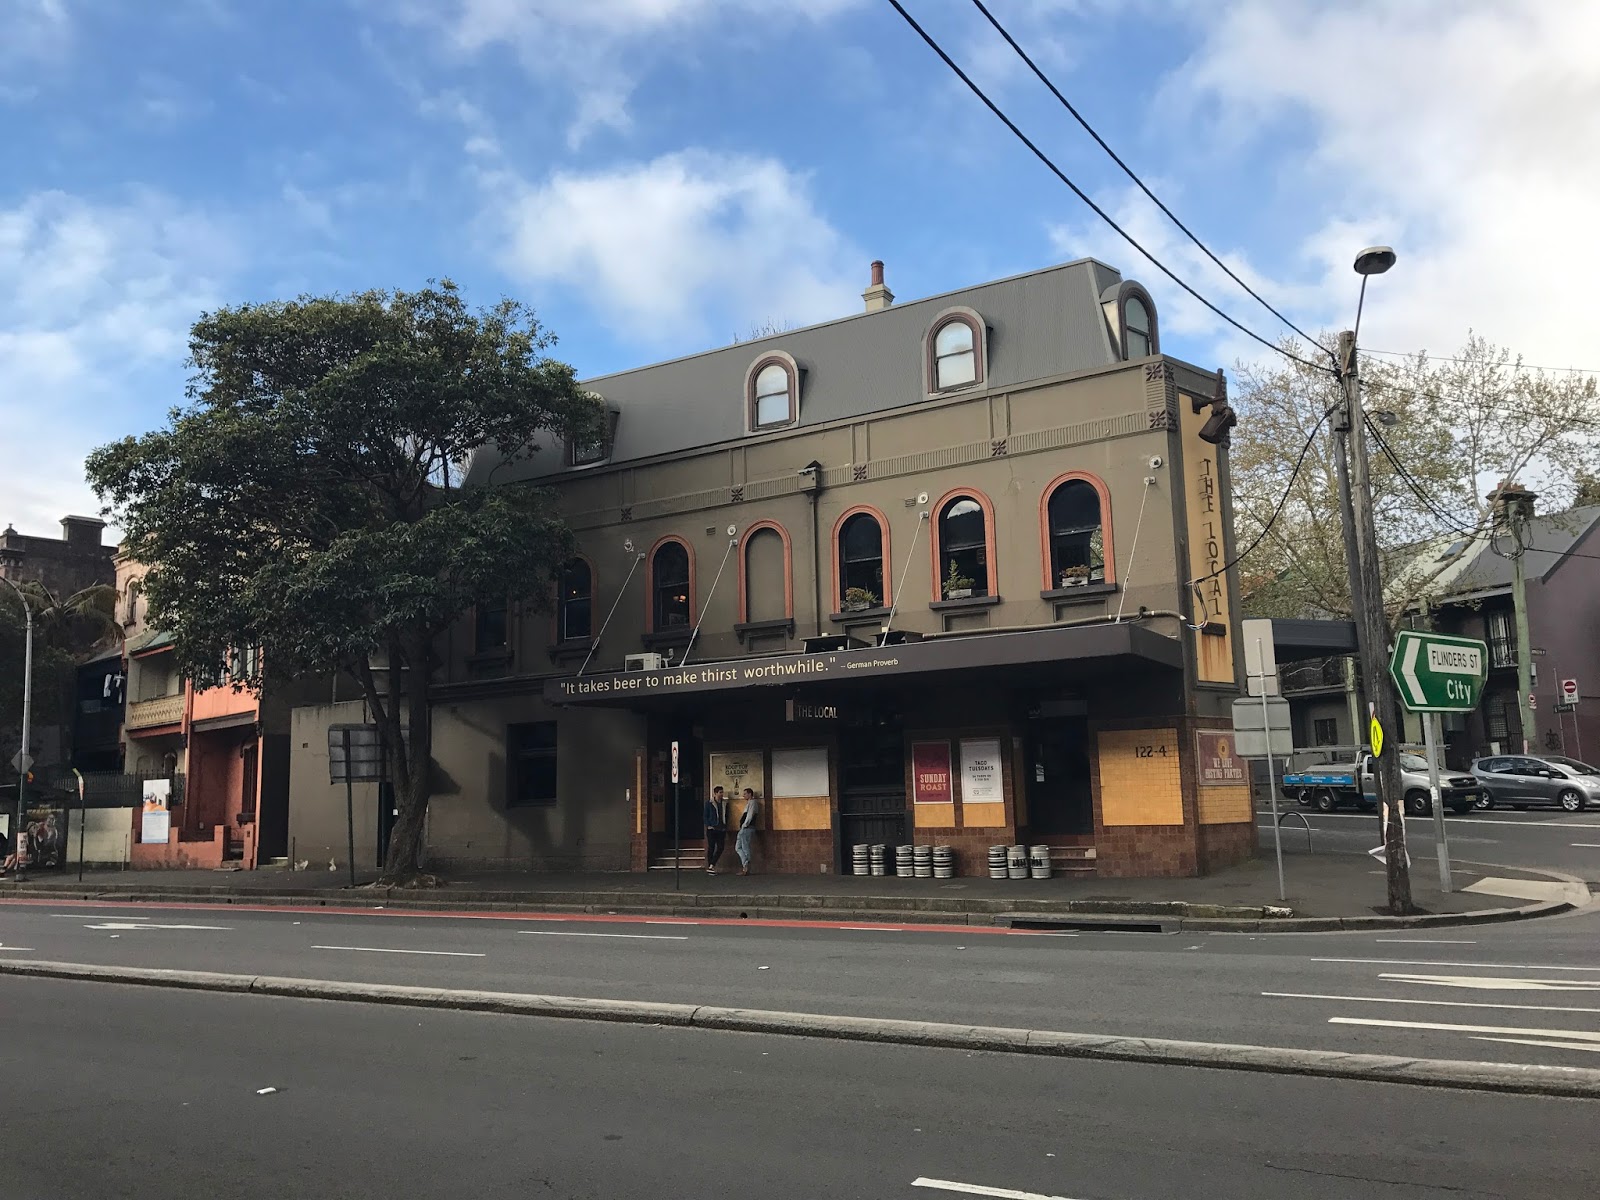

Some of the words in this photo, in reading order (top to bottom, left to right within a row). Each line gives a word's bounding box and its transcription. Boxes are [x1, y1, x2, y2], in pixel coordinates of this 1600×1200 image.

[1202, 458, 1214, 514] THE
[1432, 650, 1467, 668] FLINDERS
[1469, 654, 1478, 669] ST
[560, 682, 575, 695] "It
[578, 679, 610, 694] takes
[613, 677, 642, 690] beer
[646, 675, 659, 687] to
[663, 670, 697, 686] make
[701, 667, 737, 682] thirst
[744, 656, 836, 679] worthwhile."
[846, 661, 872, 670] German
[873, 658, 899, 667] Proverb
[1446, 679, 1471, 704] City
[798, 705, 812, 718] THE
[814, 706, 838, 718] LOCAL
[1135, 745, 1167, 758] 122-4
[1213, 757, 1221, 768] WE
[920, 773, 947, 783] SUNDAY
